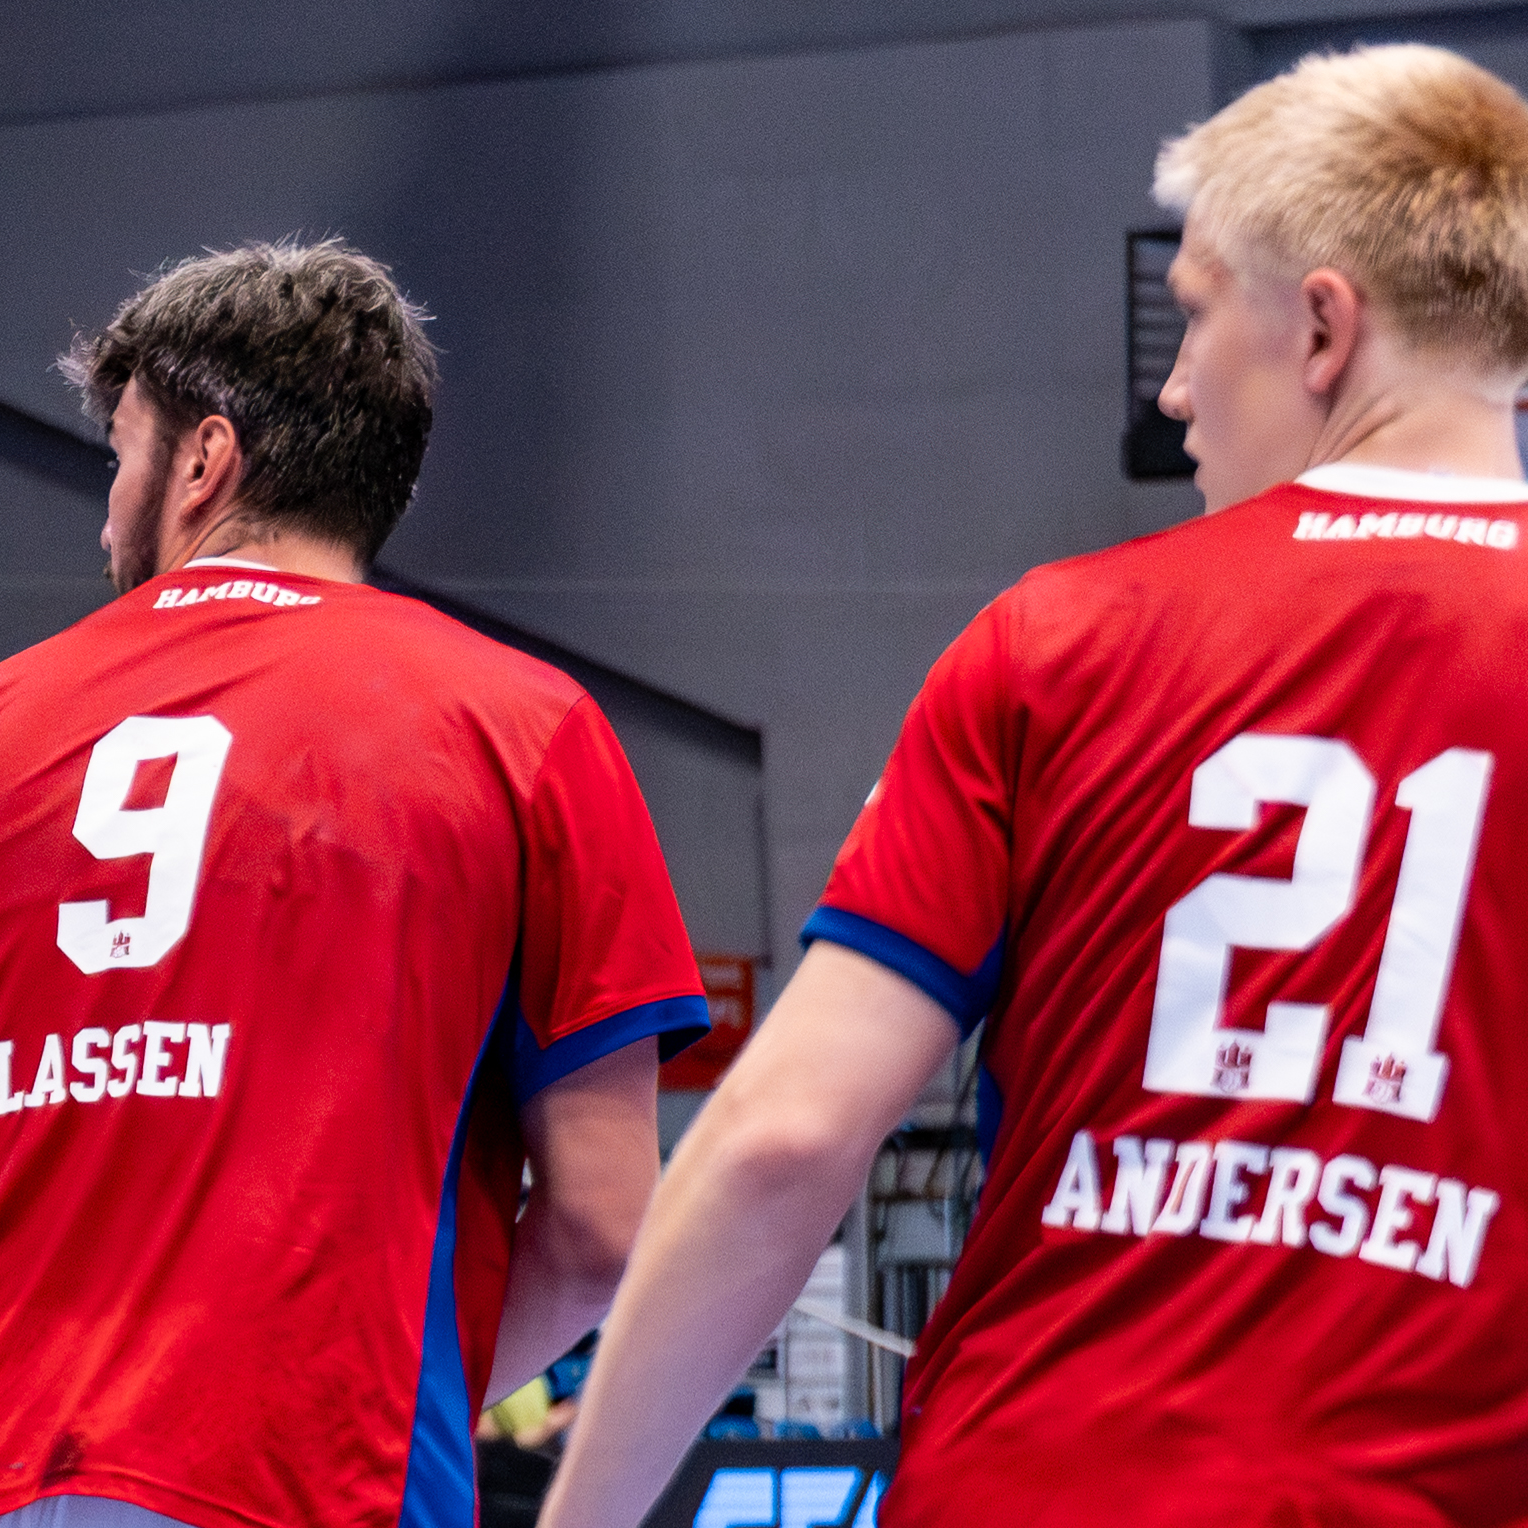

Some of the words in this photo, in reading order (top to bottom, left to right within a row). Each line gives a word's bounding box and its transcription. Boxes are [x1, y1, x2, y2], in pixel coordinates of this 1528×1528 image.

[1292, 511, 1521, 549] HAMBURG
[56, 714, 233, 975] 9
[1142, 731, 1495, 1124] 21
[1042, 1129, 1499, 1288] ANDERSEN
